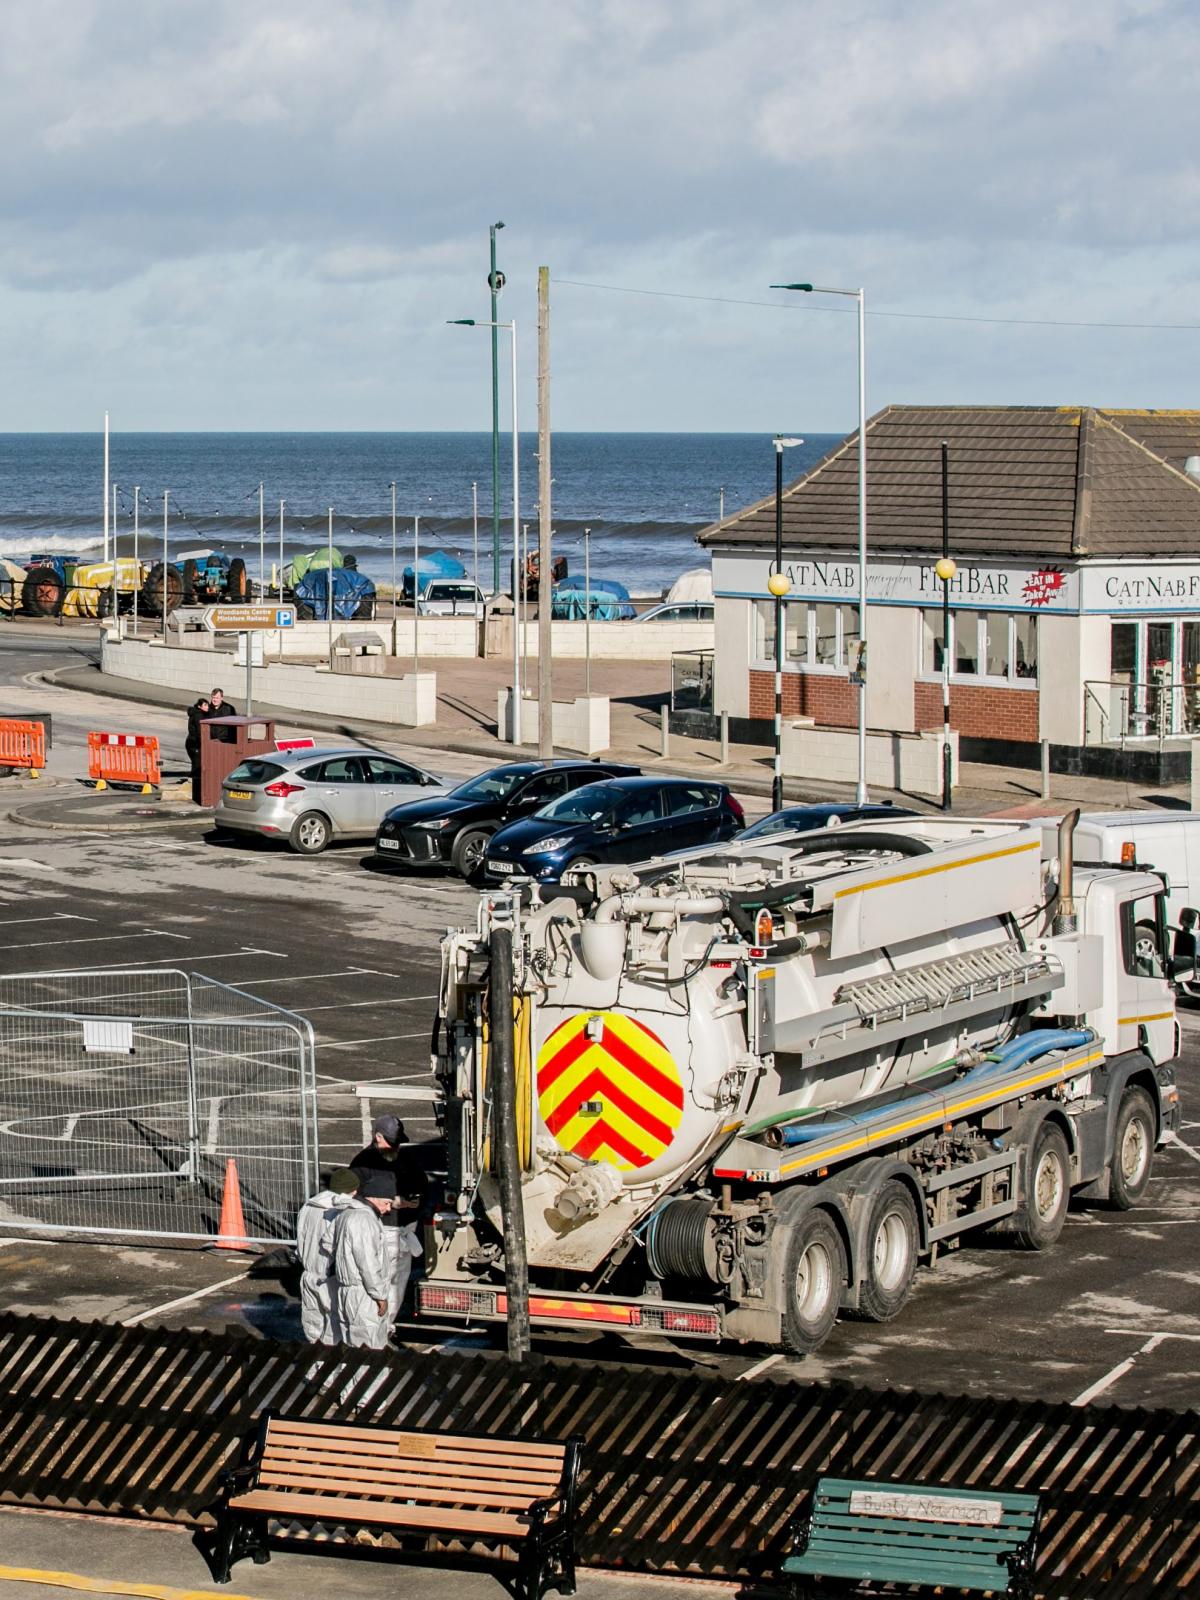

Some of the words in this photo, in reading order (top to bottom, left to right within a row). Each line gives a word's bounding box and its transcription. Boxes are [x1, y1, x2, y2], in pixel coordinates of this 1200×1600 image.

[919, 565, 1009, 595] FIHBAR
[1029, 575, 1043, 586] EAT
[1045, 574, 1054, 584] IN
[280, 611, 291, 625] P
